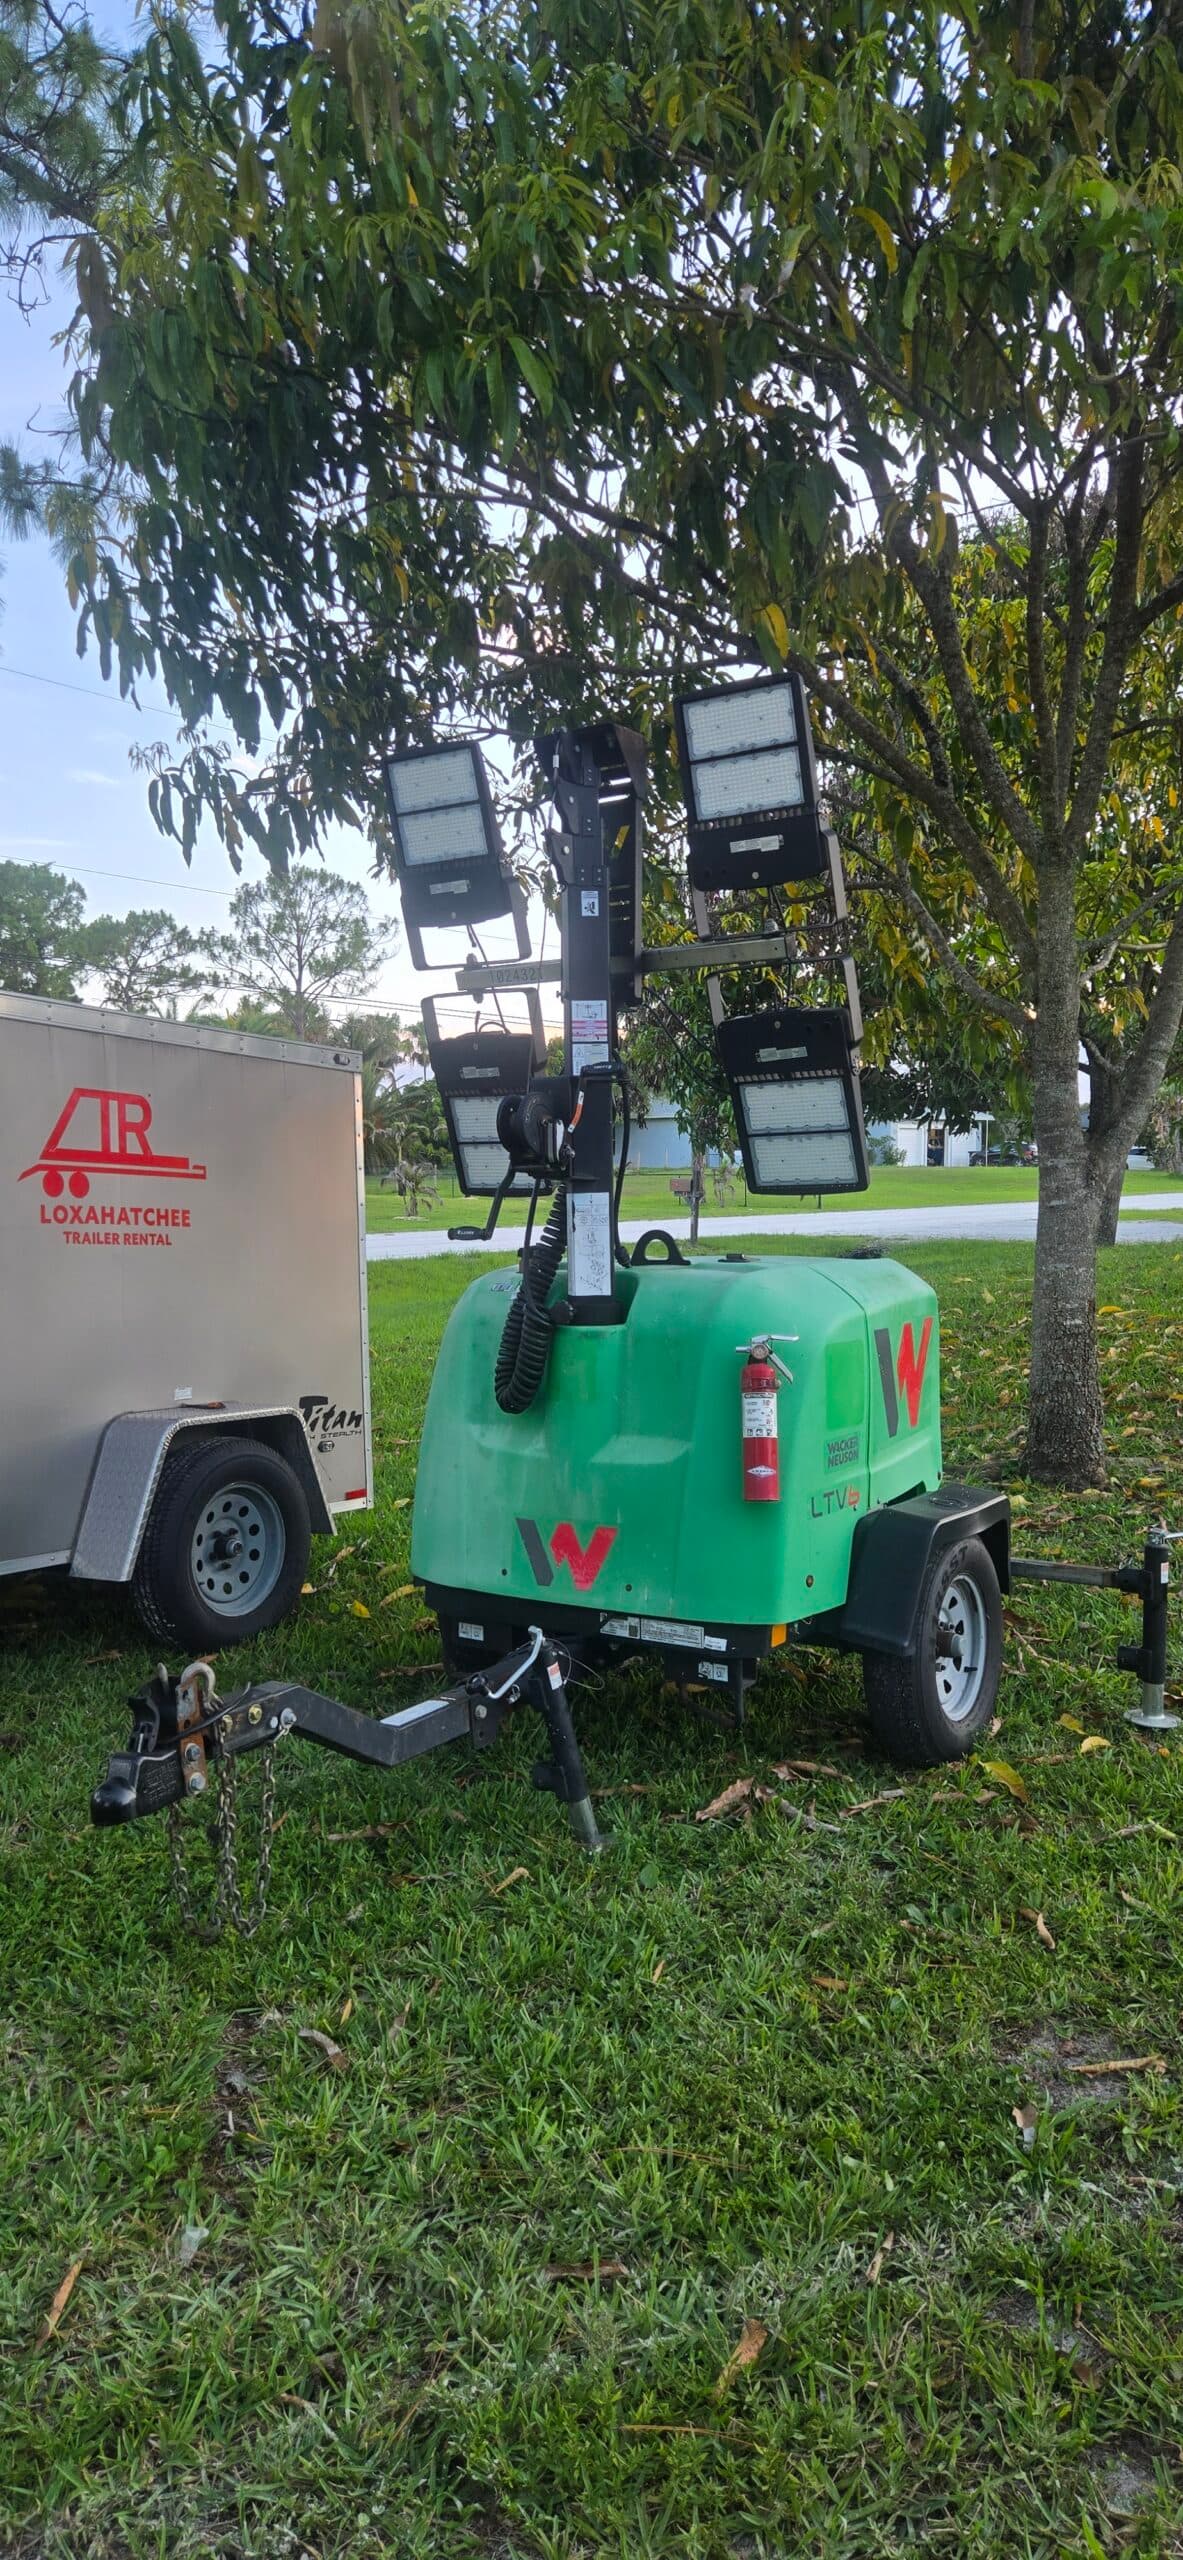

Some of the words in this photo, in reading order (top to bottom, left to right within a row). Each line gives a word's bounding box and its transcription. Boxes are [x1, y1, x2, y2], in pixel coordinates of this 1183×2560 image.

[40, 1204, 191, 1227] LOXAHATCHEE
[63, 1231, 120, 1245] TRAILER
[123, 1233, 172, 1246] RENTAL
[299, 1395, 362, 1432] Titan
[320, 1429, 362, 1440] STEALTH
[827, 1435, 859, 1454] WACKER
[827, 1449, 859, 1469] NEUSON
